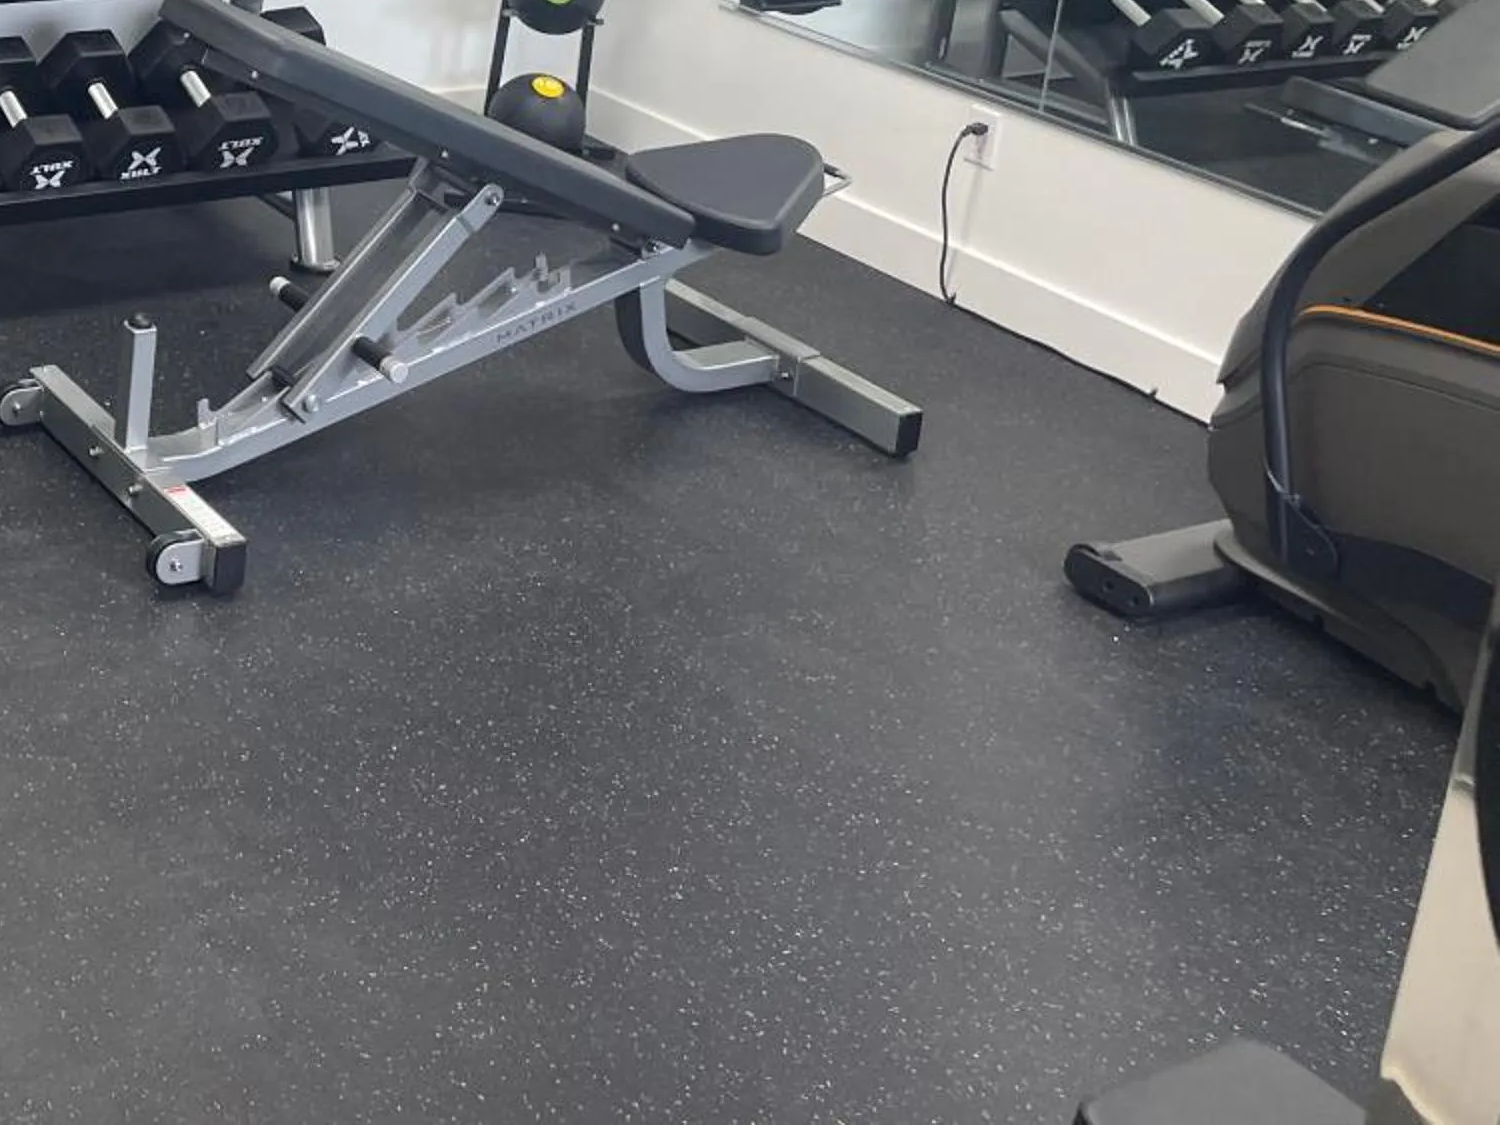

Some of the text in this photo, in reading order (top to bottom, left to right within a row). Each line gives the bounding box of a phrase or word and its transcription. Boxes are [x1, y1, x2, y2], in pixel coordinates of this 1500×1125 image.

[218, 136, 265, 151] XULT
[30, 160, 74, 176] XULT
[496, 299, 577, 344] MATRIX
